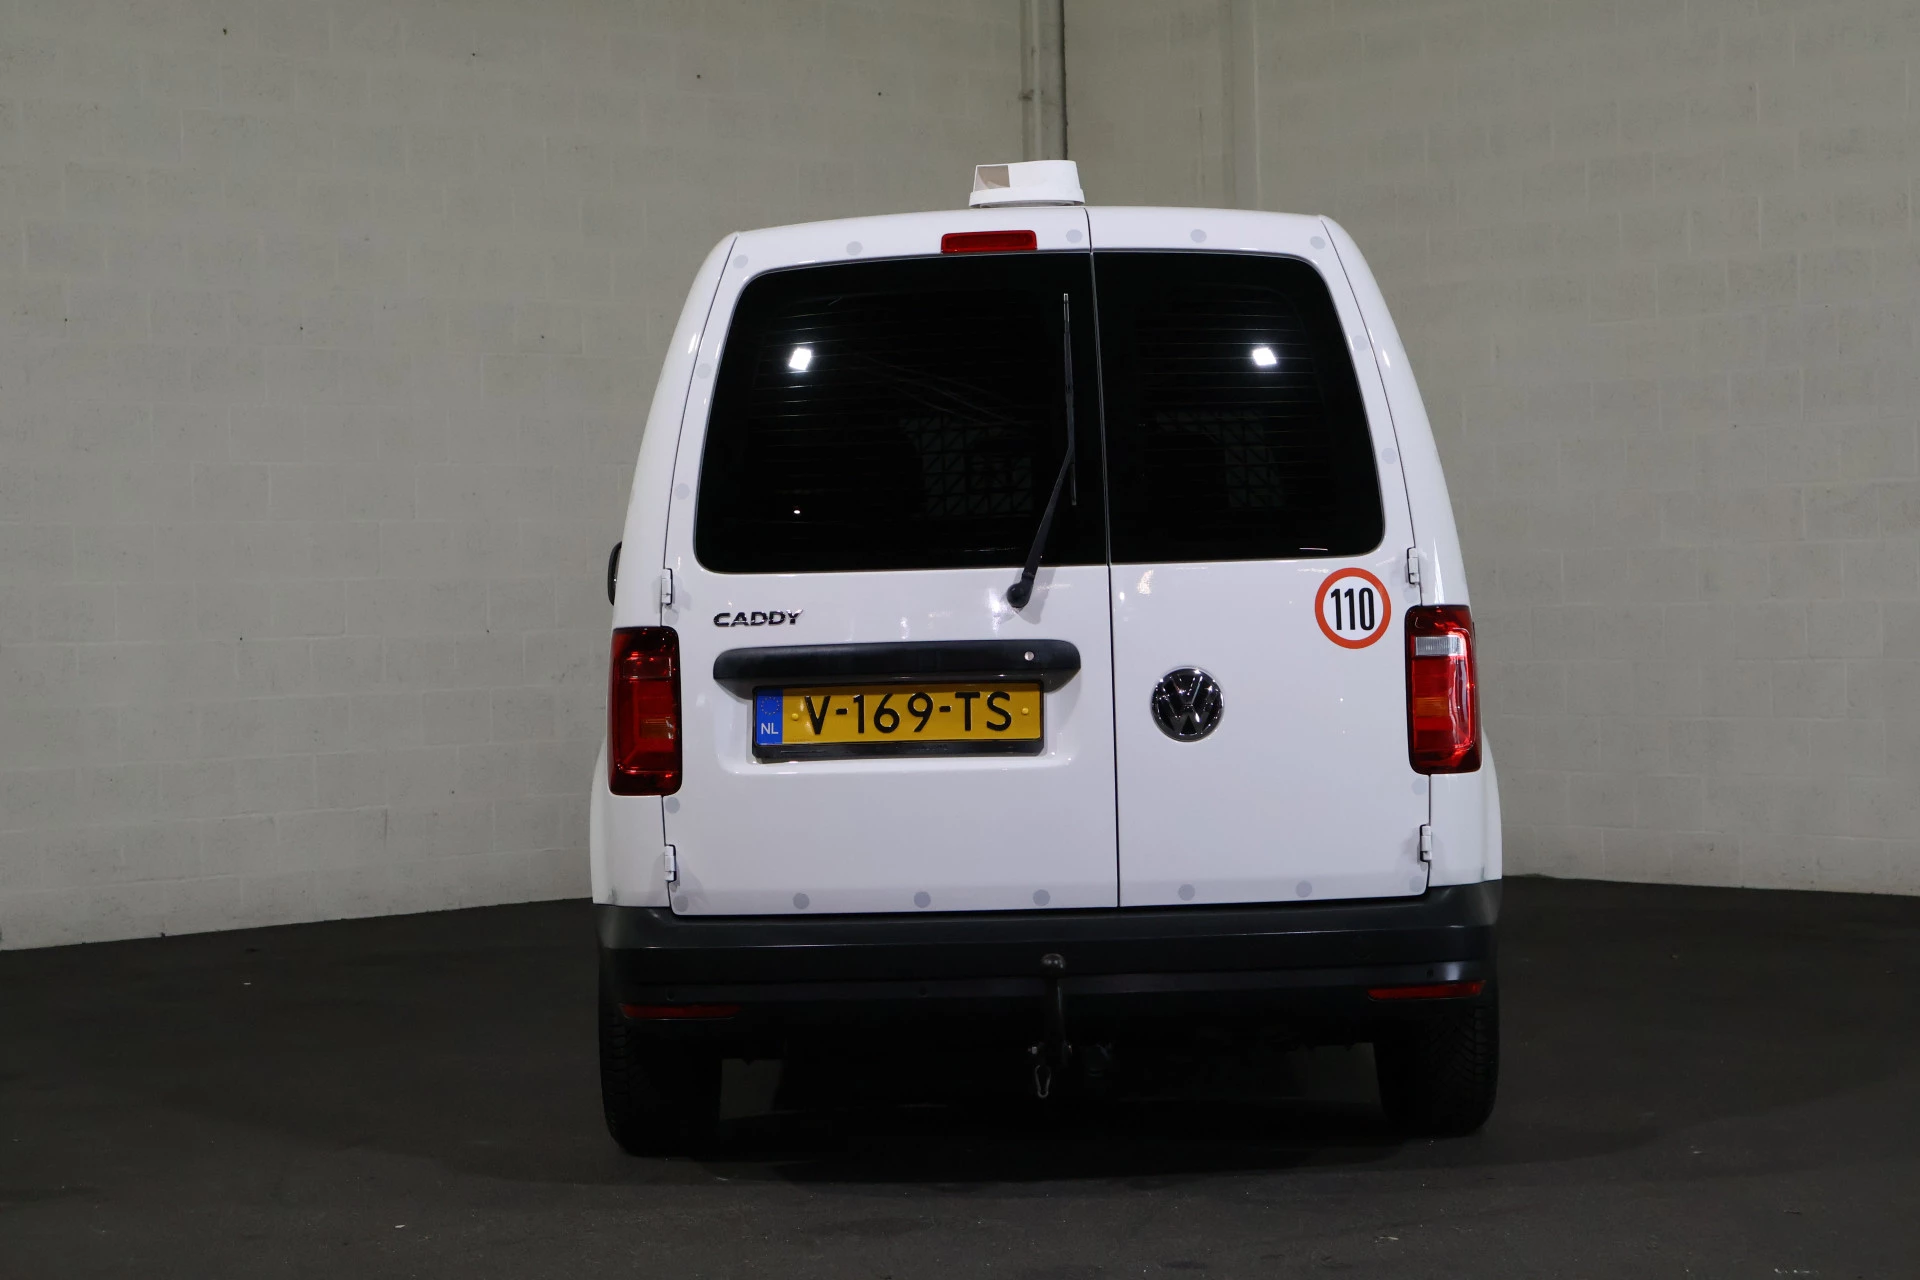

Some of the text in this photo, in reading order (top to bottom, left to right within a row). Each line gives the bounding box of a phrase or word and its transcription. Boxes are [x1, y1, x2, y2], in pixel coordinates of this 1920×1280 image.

[713, 610, 803, 627] CADDY
[1330, 587, 1375, 631] 110
[805, 691, 1012, 735] V-169-TS
[761, 723, 779, 735] NL
